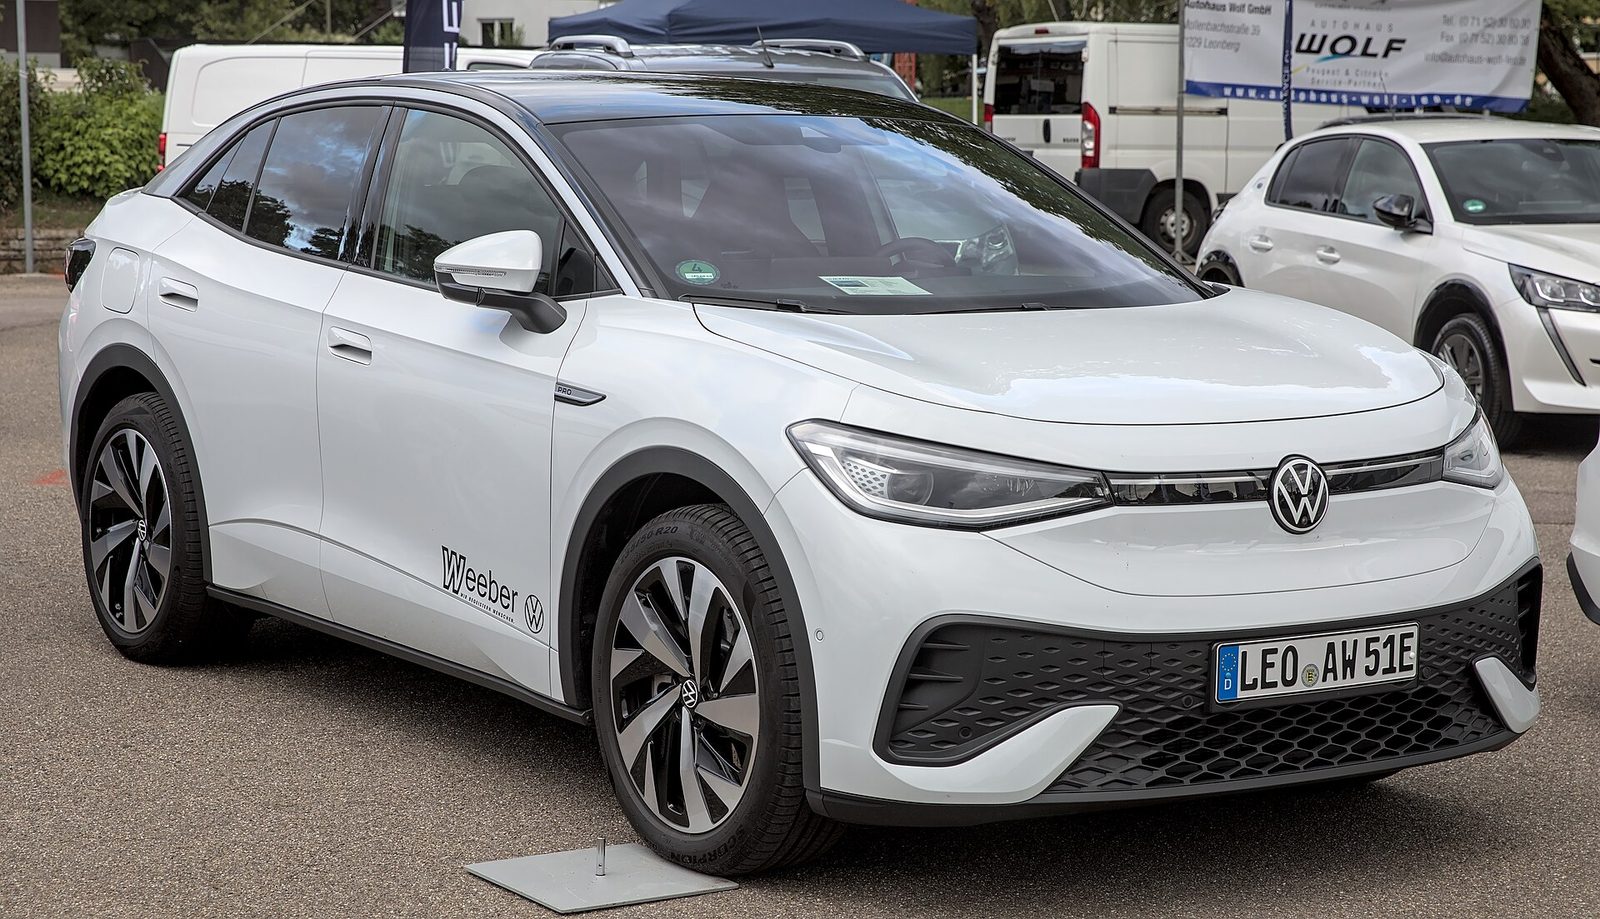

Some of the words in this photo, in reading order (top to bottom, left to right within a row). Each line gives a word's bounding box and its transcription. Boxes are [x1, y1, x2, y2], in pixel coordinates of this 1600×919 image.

[1247, 3, 1272, 15] GmbH
[1310, 19, 1393, 33] AUTOHAUS
[1295, 33, 1407, 58] WOLF
[557, 386, 572, 396] PRO
[441, 545, 518, 613] Weeber
[1240, 645, 1298, 691] LEO
[1322, 639, 1358, 683] AW
[1364, 631, 1415, 677] 51E
